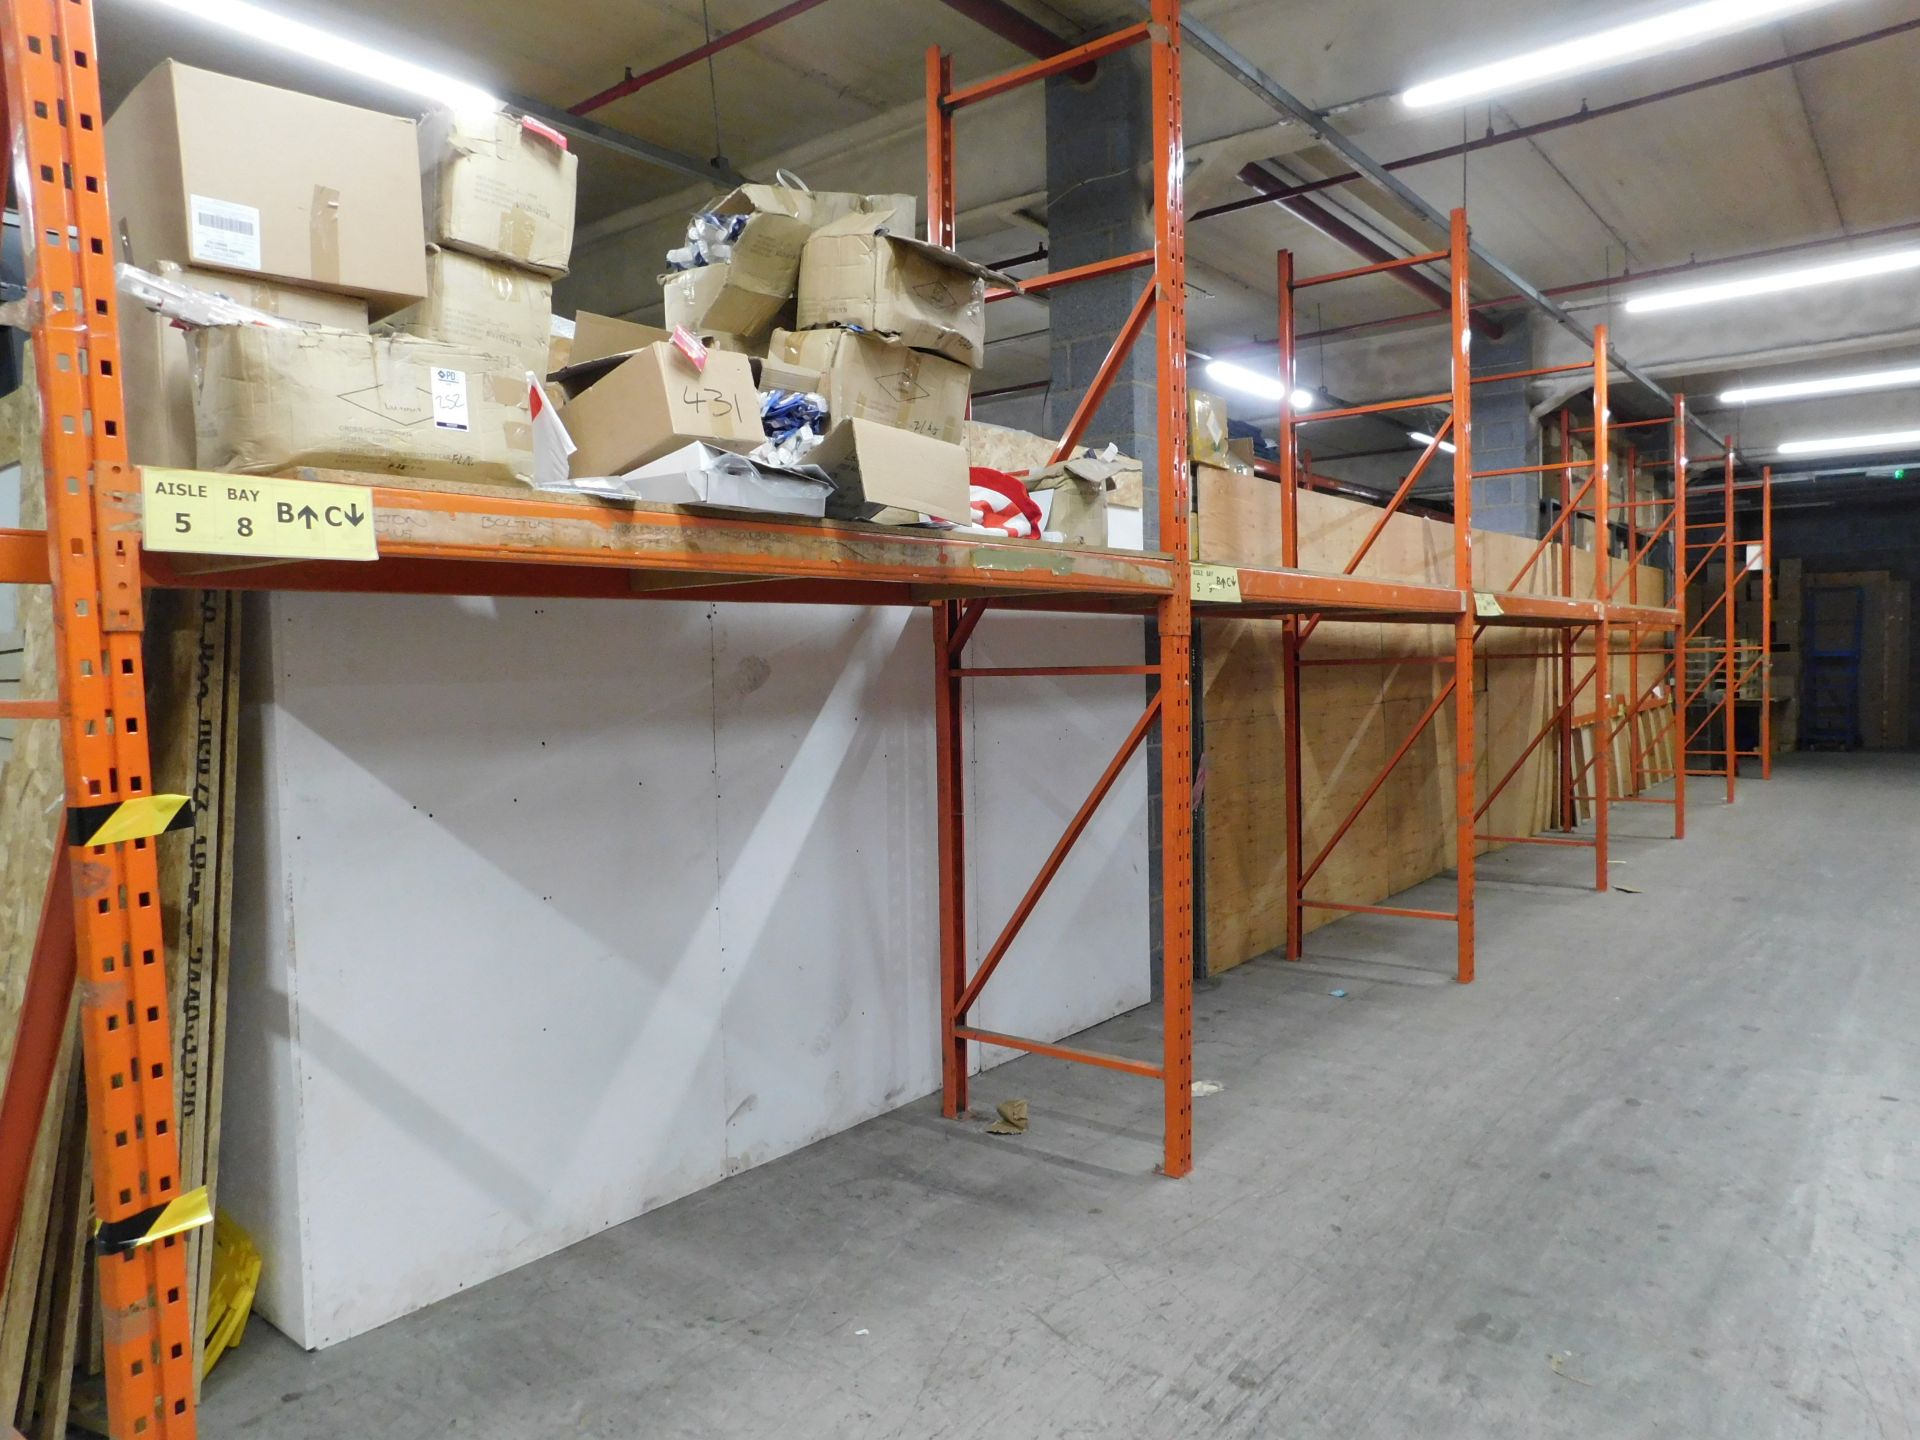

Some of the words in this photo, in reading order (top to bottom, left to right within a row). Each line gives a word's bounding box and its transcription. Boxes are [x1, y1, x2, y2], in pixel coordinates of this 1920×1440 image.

[683, 385, 742, 423] 431
[155, 481, 208, 498] AISLE
[227, 487, 260, 502] BAY
[175, 512, 192, 533] 5
[237, 517, 254, 537] 8
[276, 502, 295, 524] B
[324, 505, 343, 527] C
